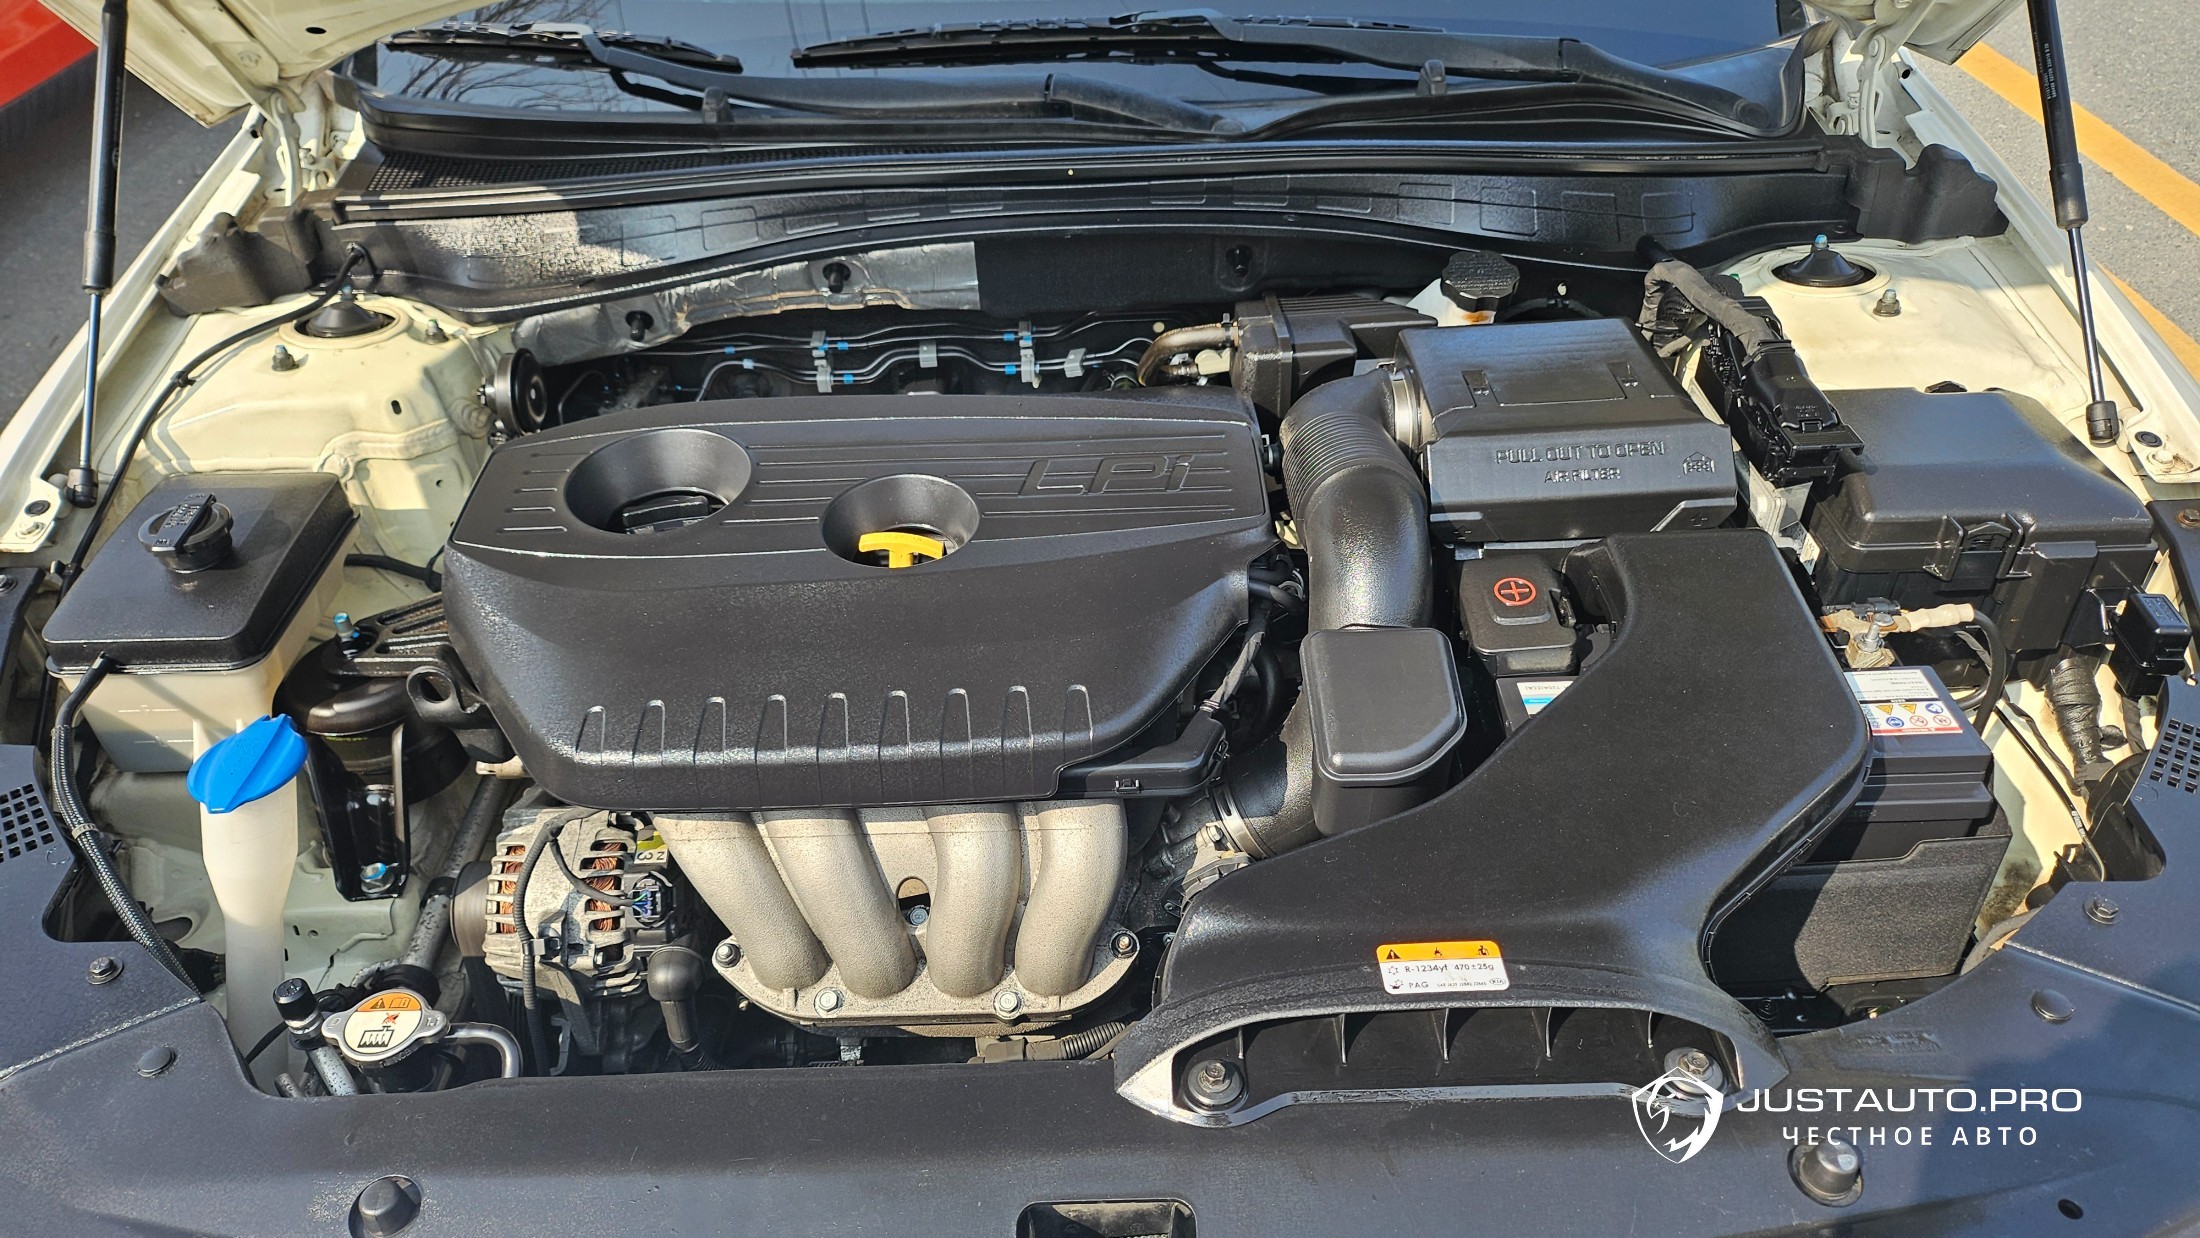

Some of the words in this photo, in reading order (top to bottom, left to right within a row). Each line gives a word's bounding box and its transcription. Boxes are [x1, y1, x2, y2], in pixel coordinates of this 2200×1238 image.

[1494, 447, 1543, 464] PULL
[1546, 445, 1583, 461] OUT
[1588, 443, 1611, 459] TO
[1615, 441, 1665, 457] OPEN
[1018, 454, 1195, 498] LPi
[1544, 469, 1570, 483] AIR
[1572, 467, 1621, 481] FILTER
[1405, 963, 1449, 973] R-1234yf
[1454, 963, 1494, 971] 470±25g
